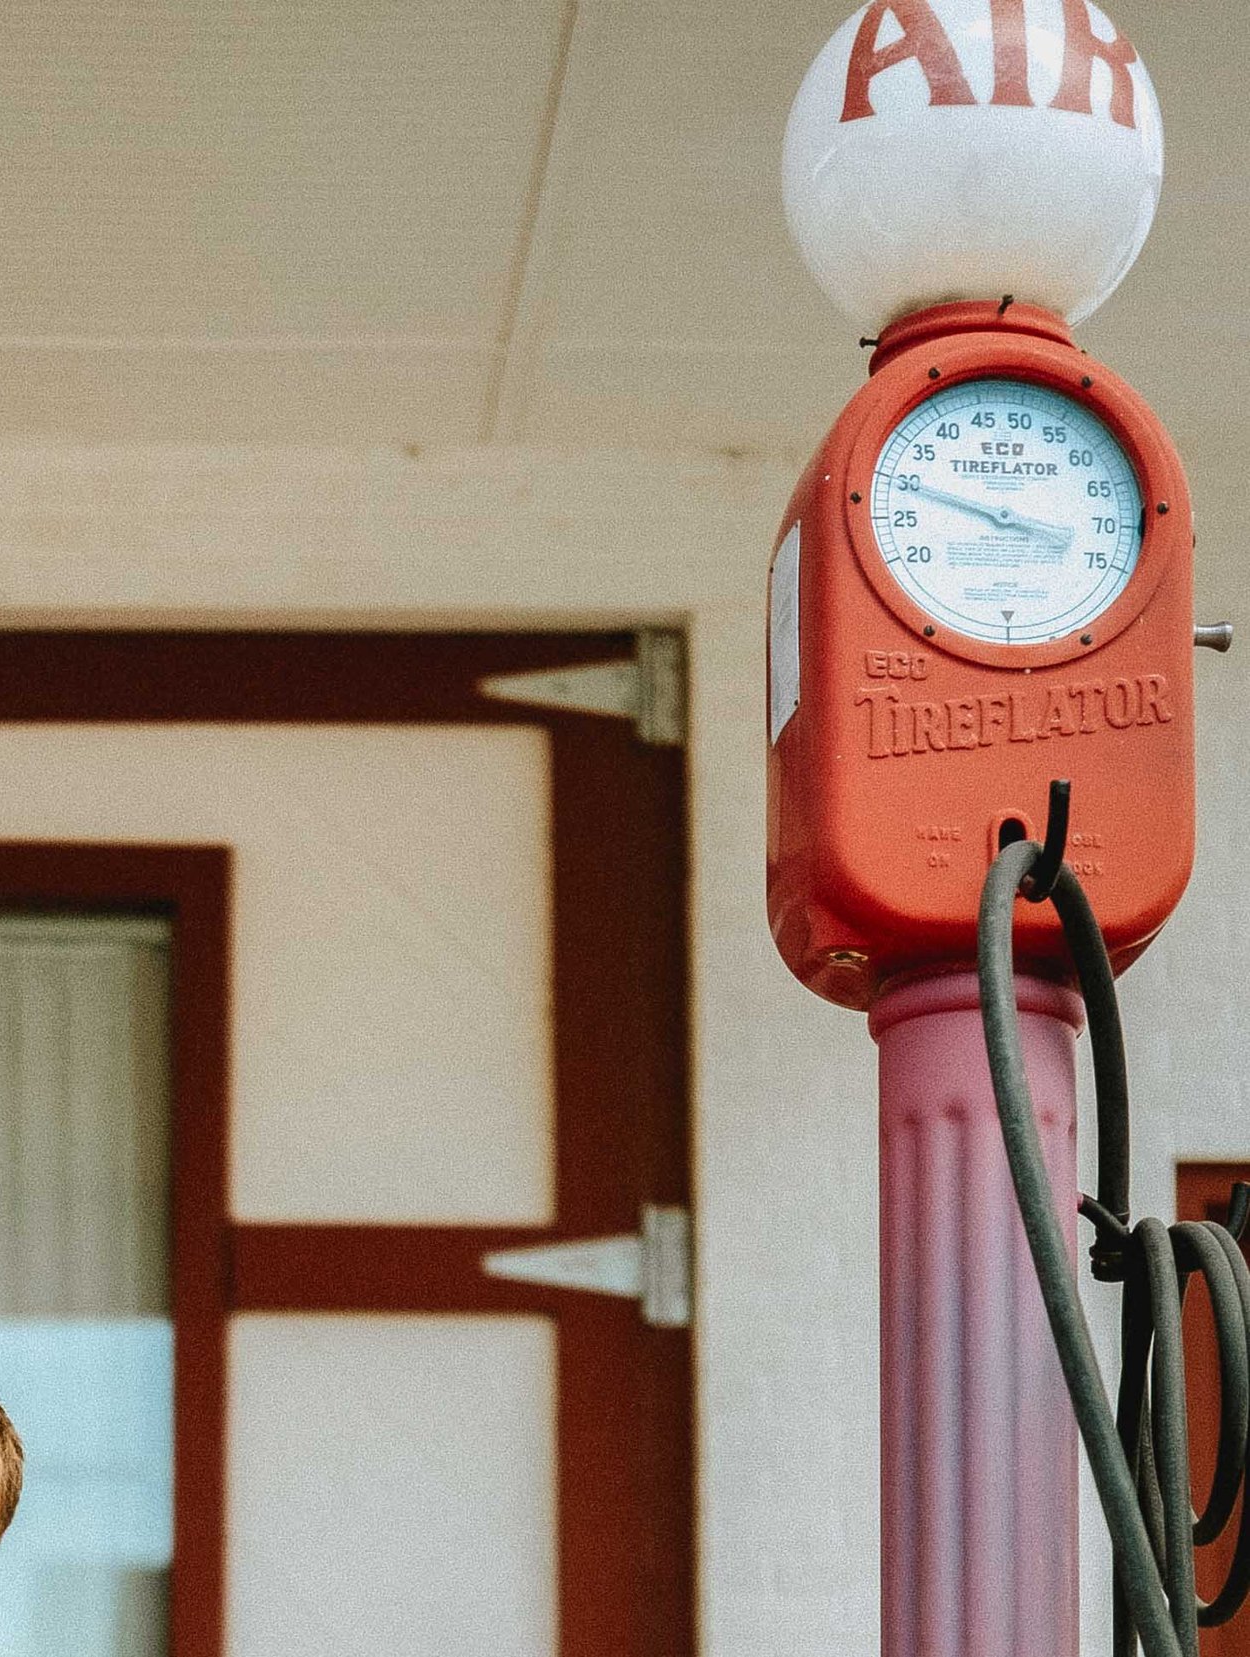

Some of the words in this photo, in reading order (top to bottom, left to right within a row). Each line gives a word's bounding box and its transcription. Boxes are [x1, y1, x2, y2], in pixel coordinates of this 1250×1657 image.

[838, 0, 1138, 129] AIR
[970, 411, 996, 429] 45
[1007, 412, 1032, 430] 50
[935, 422, 960, 440] 40
[1042, 426, 1066, 444] 55
[912, 443, 936, 461] 35
[980, 442, 1025, 456] ECO
[1069, 449, 1093, 467] 60
[949, 459, 1059, 476] TIREFLATOR
[896, 474, 921, 492] 30
[1087, 480, 1111, 498] 65
[893, 510, 918, 528] 25
[1091, 516, 1116, 534] 70
[906, 545, 931, 564] 20
[1083, 552, 1108, 570] 75
[865, 650, 930, 681] ECO
[854, 673, 1174, 760] TIREFLATOR
